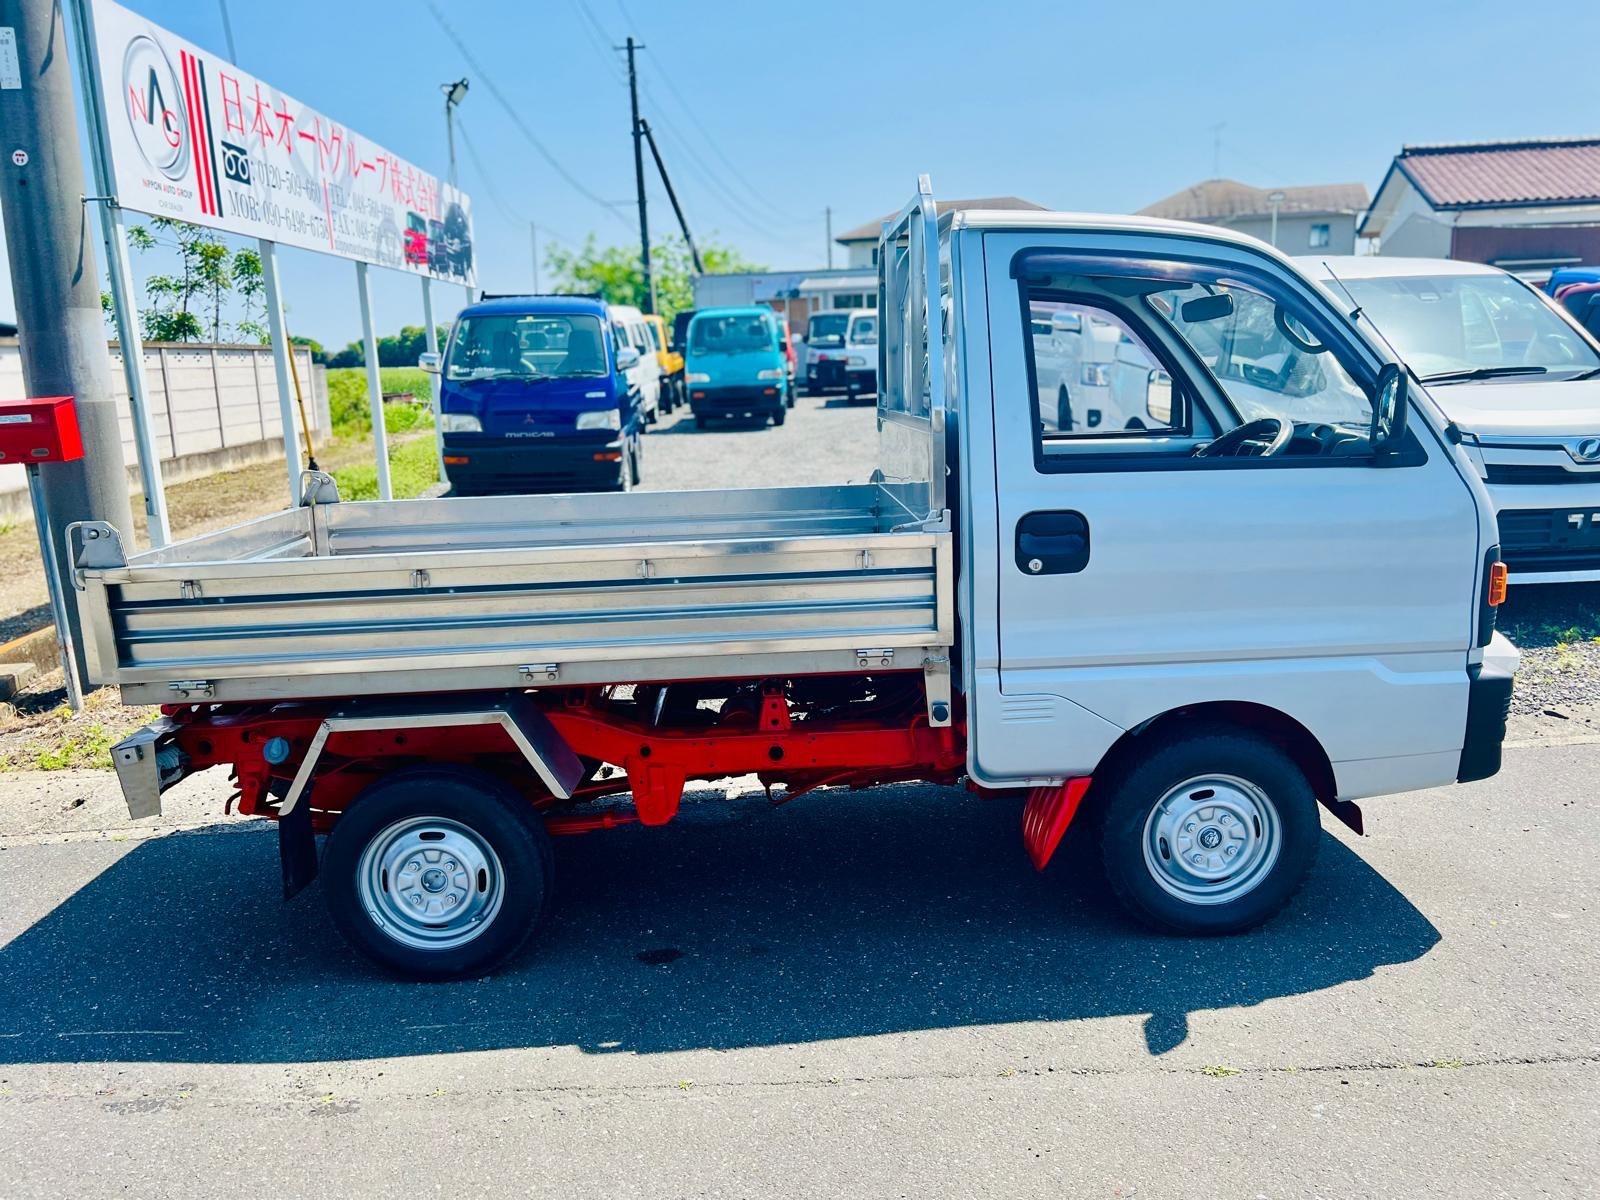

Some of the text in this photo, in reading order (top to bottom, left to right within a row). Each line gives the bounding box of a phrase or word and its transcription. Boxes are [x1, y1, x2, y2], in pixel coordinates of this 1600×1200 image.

[219, 71, 441, 219] 日本オートグループ株式会社
